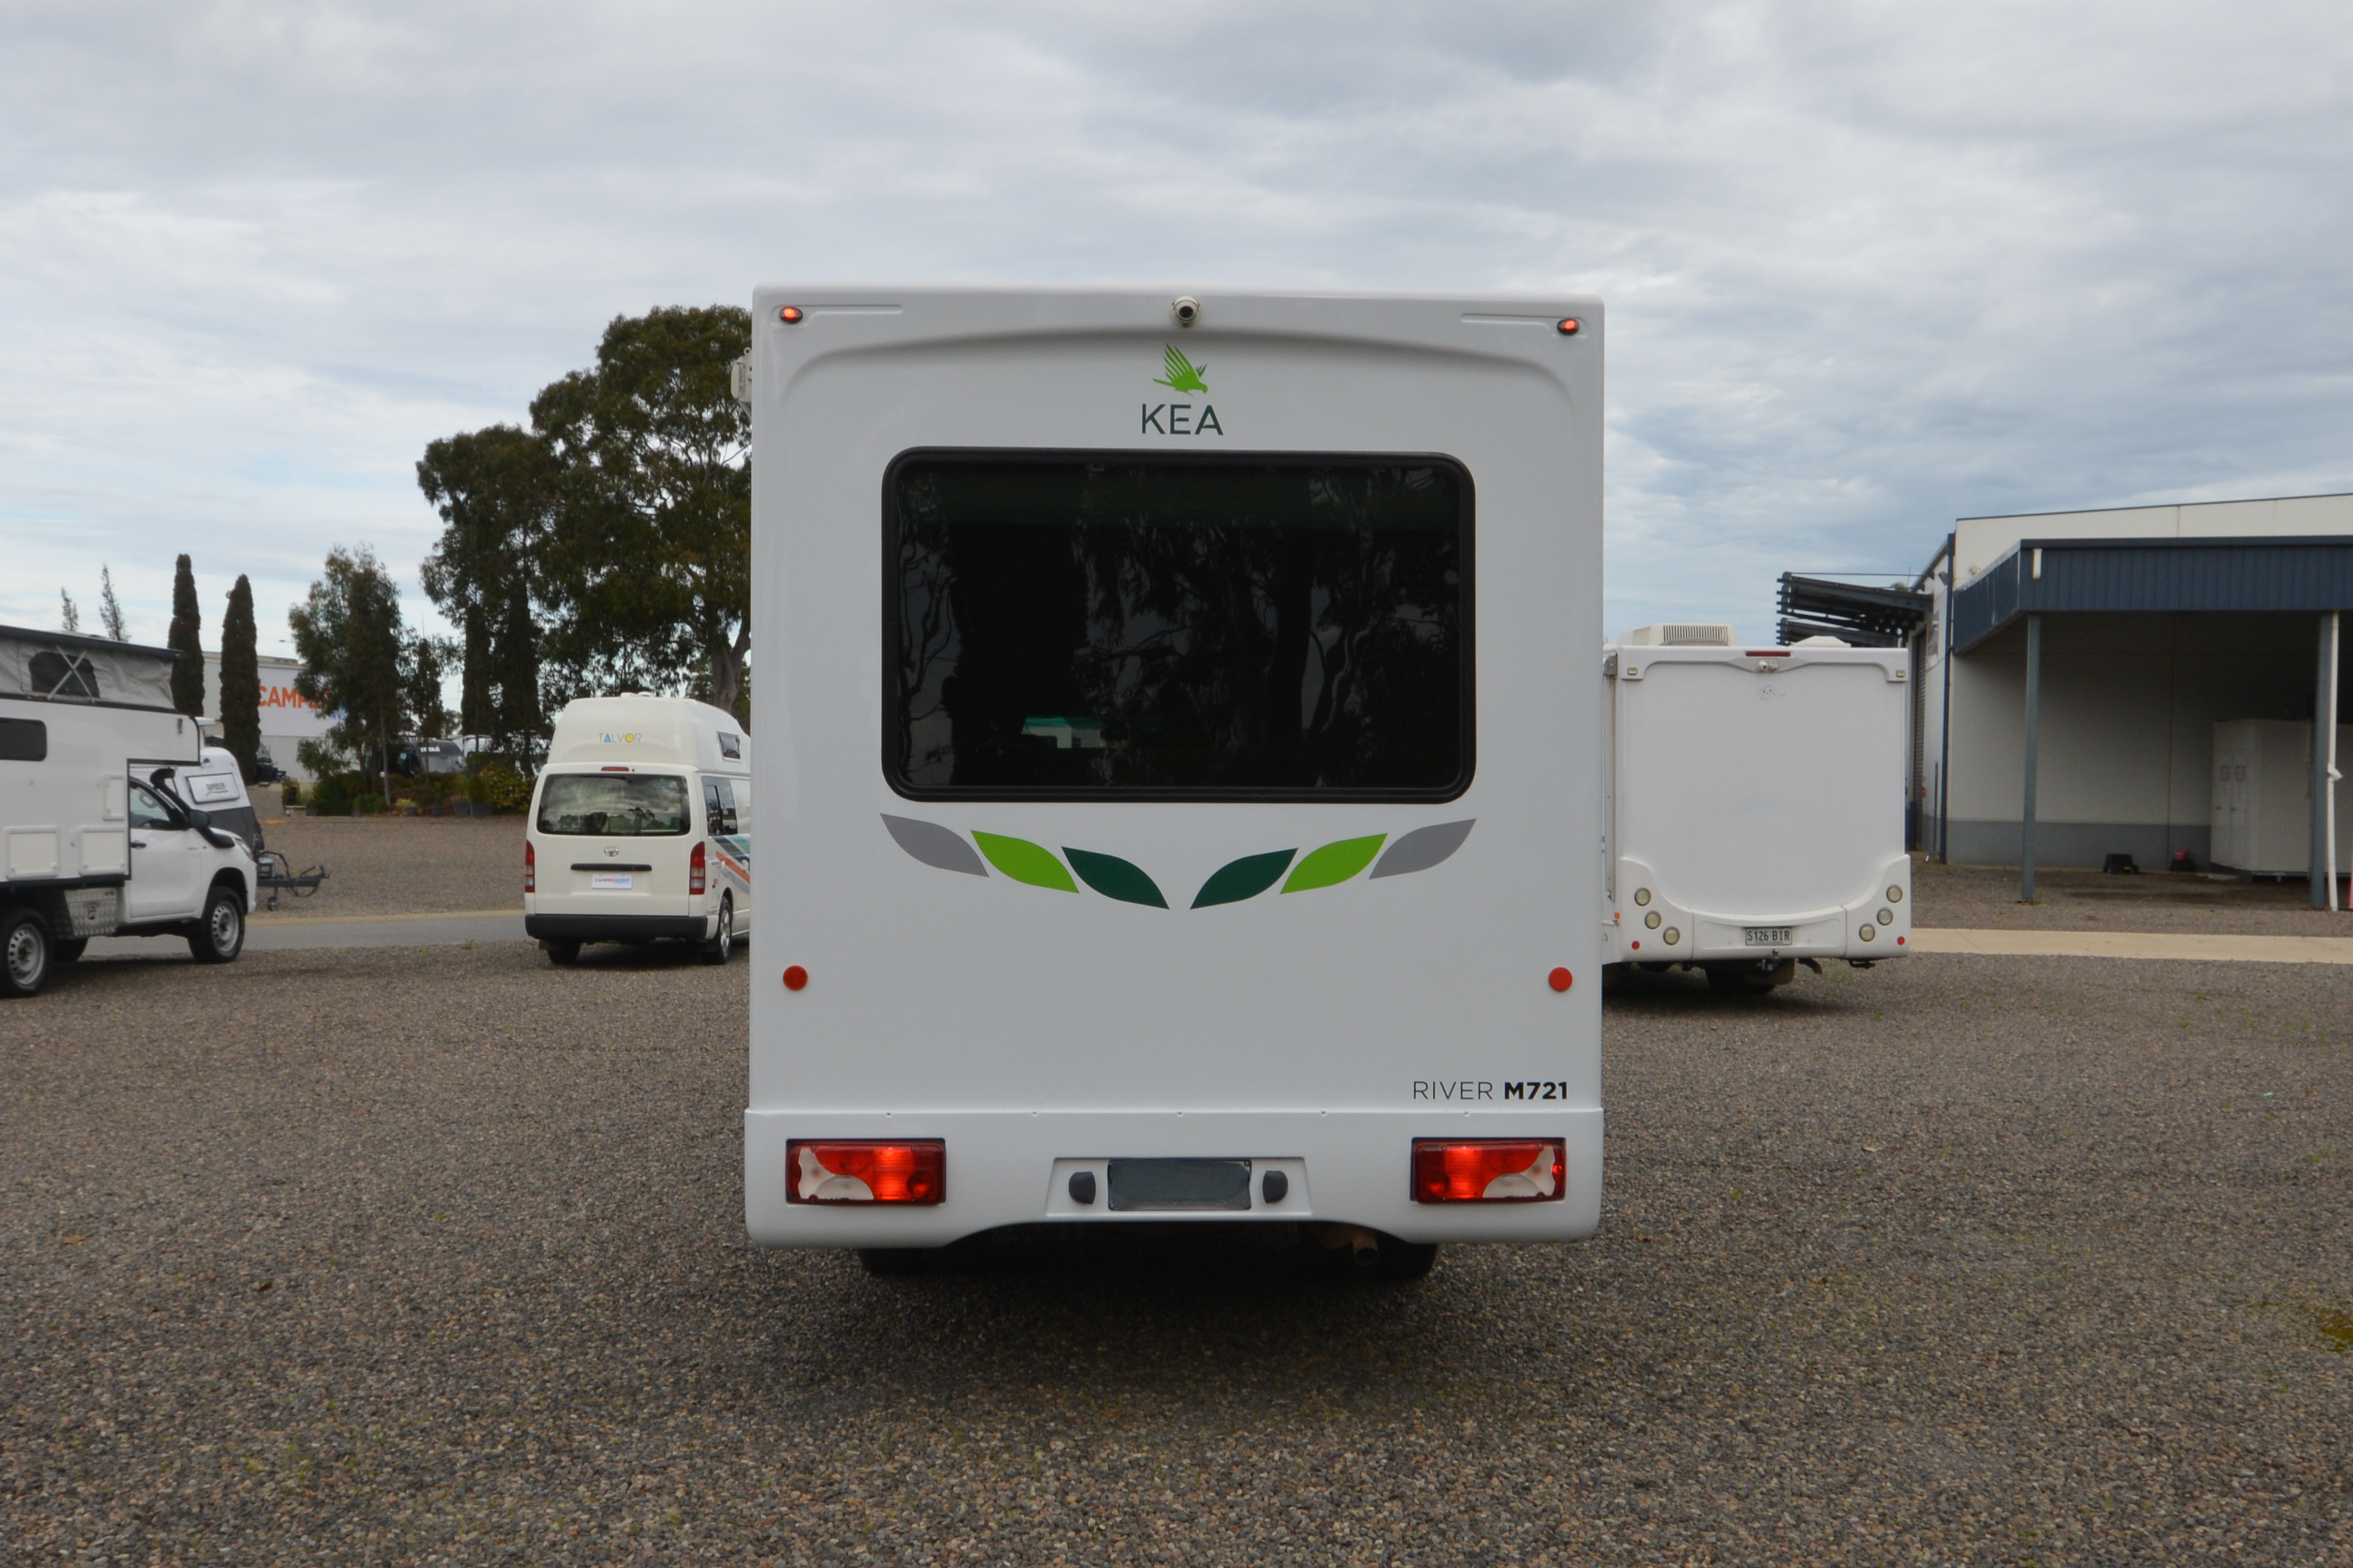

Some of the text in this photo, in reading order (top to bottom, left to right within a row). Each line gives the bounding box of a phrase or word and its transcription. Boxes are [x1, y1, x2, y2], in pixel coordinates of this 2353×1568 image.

[1141, 404, 1223, 435] KEA
[598, 732, 642, 743] TALVOR
[1413, 1080, 1567, 1099] RIVER M721
